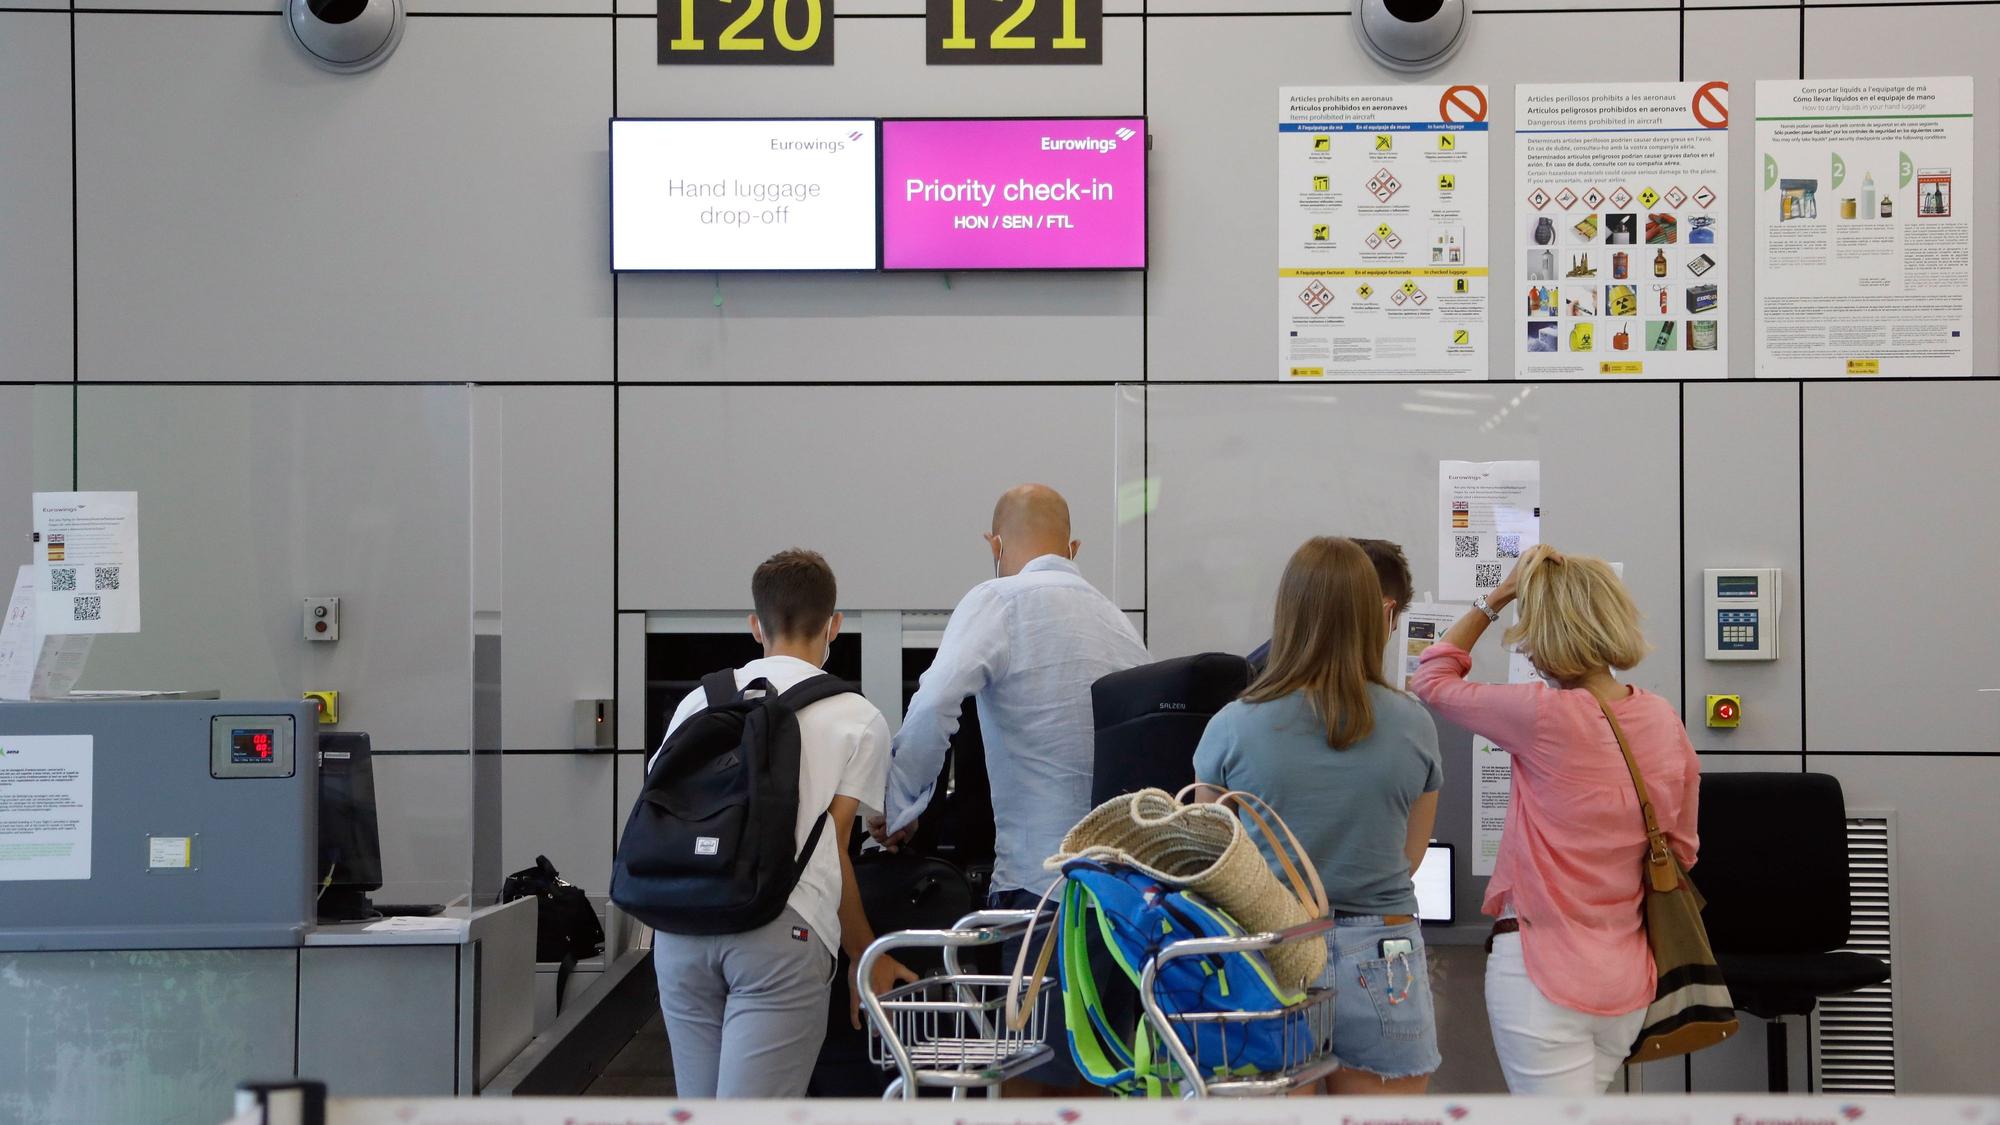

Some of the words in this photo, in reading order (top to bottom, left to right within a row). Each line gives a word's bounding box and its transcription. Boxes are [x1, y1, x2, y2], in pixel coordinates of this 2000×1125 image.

[671, 0, 822, 51] 120
[942, 0, 1087, 50] 121
[1818, 87, 1838, 95] portar
[1877, 94, 1905, 102] equipaje
[1318, 95, 1349, 103] prohibits
[1556, 95, 1589, 103] perillosos
[1591, 95, 1623, 103] prohibits
[1323, 104, 1360, 112] prohibidos
[1560, 107, 1597, 115] peligrosos
[1599, 106, 1637, 114] prohibidos
[1310, 114, 1344, 122] prohibited
[1528, 119, 1566, 127] Dangerous
[1589, 118, 1626, 126] prohibited
[770, 138, 845, 153] Eurowings
[1041, 137, 1117, 154] Eurowings
[1767, 164, 1775, 178] 1
[1833, 163, 1844, 177] 2
[1901, 162, 1911, 176] 3
[668, 179, 726, 199] Hand
[733, 179, 821, 206] luggage
[905, 178, 995, 207] Priority
[1002, 178, 1113, 203] check-in
[699, 205, 790, 228] drop-off
[953, 216, 988, 230] HON
[992, 216, 999, 230] /
[1001, 216, 1034, 230] SEN
[1037, 216, 1044, 230] /
[1046, 216, 1074, 230] FTL
[1159, 702, 1186, 710] SALZEN
